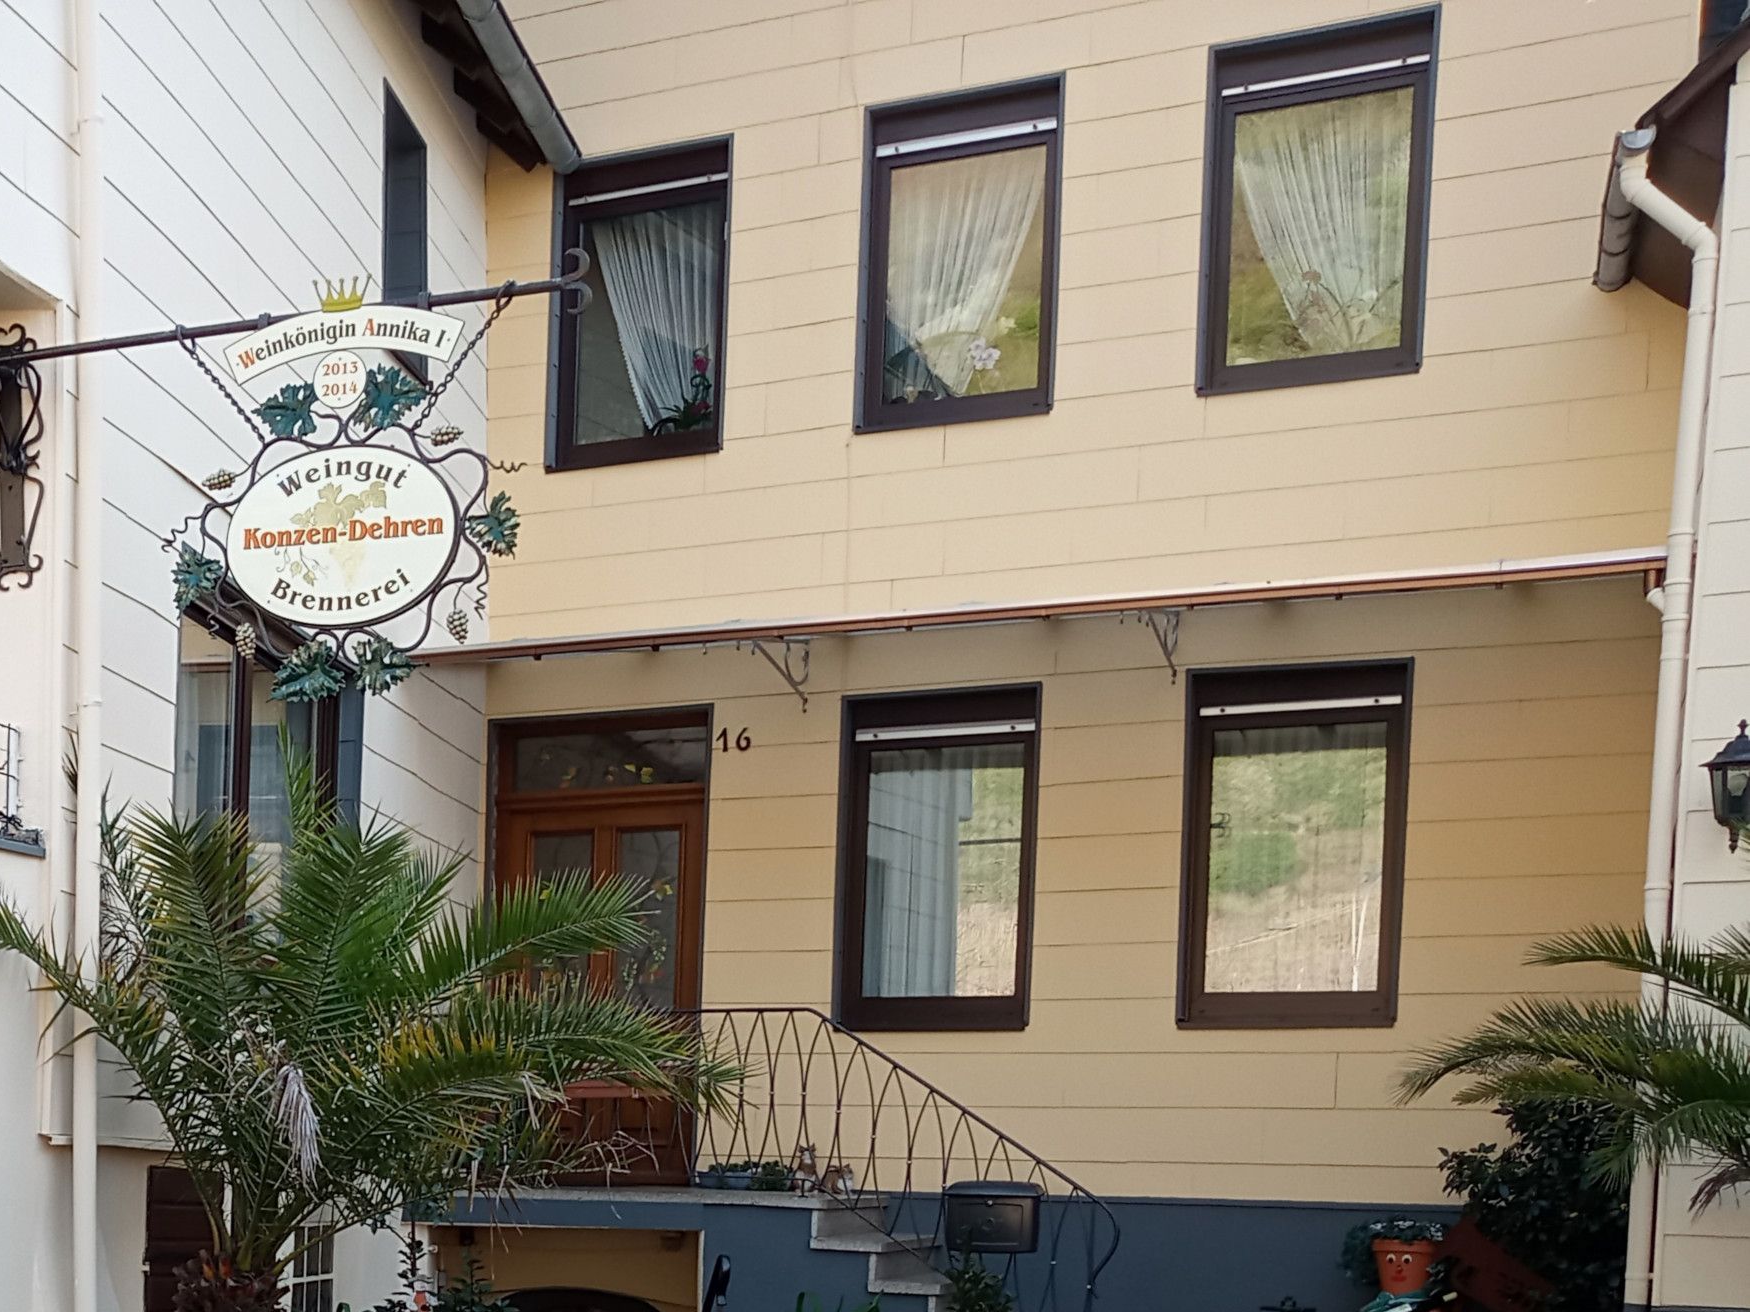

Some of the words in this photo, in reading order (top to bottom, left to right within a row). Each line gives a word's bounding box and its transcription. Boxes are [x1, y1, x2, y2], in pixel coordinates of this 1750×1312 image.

[238, 319, 356, 370] Weinkönigin
[362, 318, 431, 344] Annika
[321, 381, 358, 397] 2014
[277, 458, 408, 497] Weingut
[243, 516, 444, 550] Konzen-Dehren
[271, 568, 411, 611] Brennerei
[715, 727, 752, 752] 16
